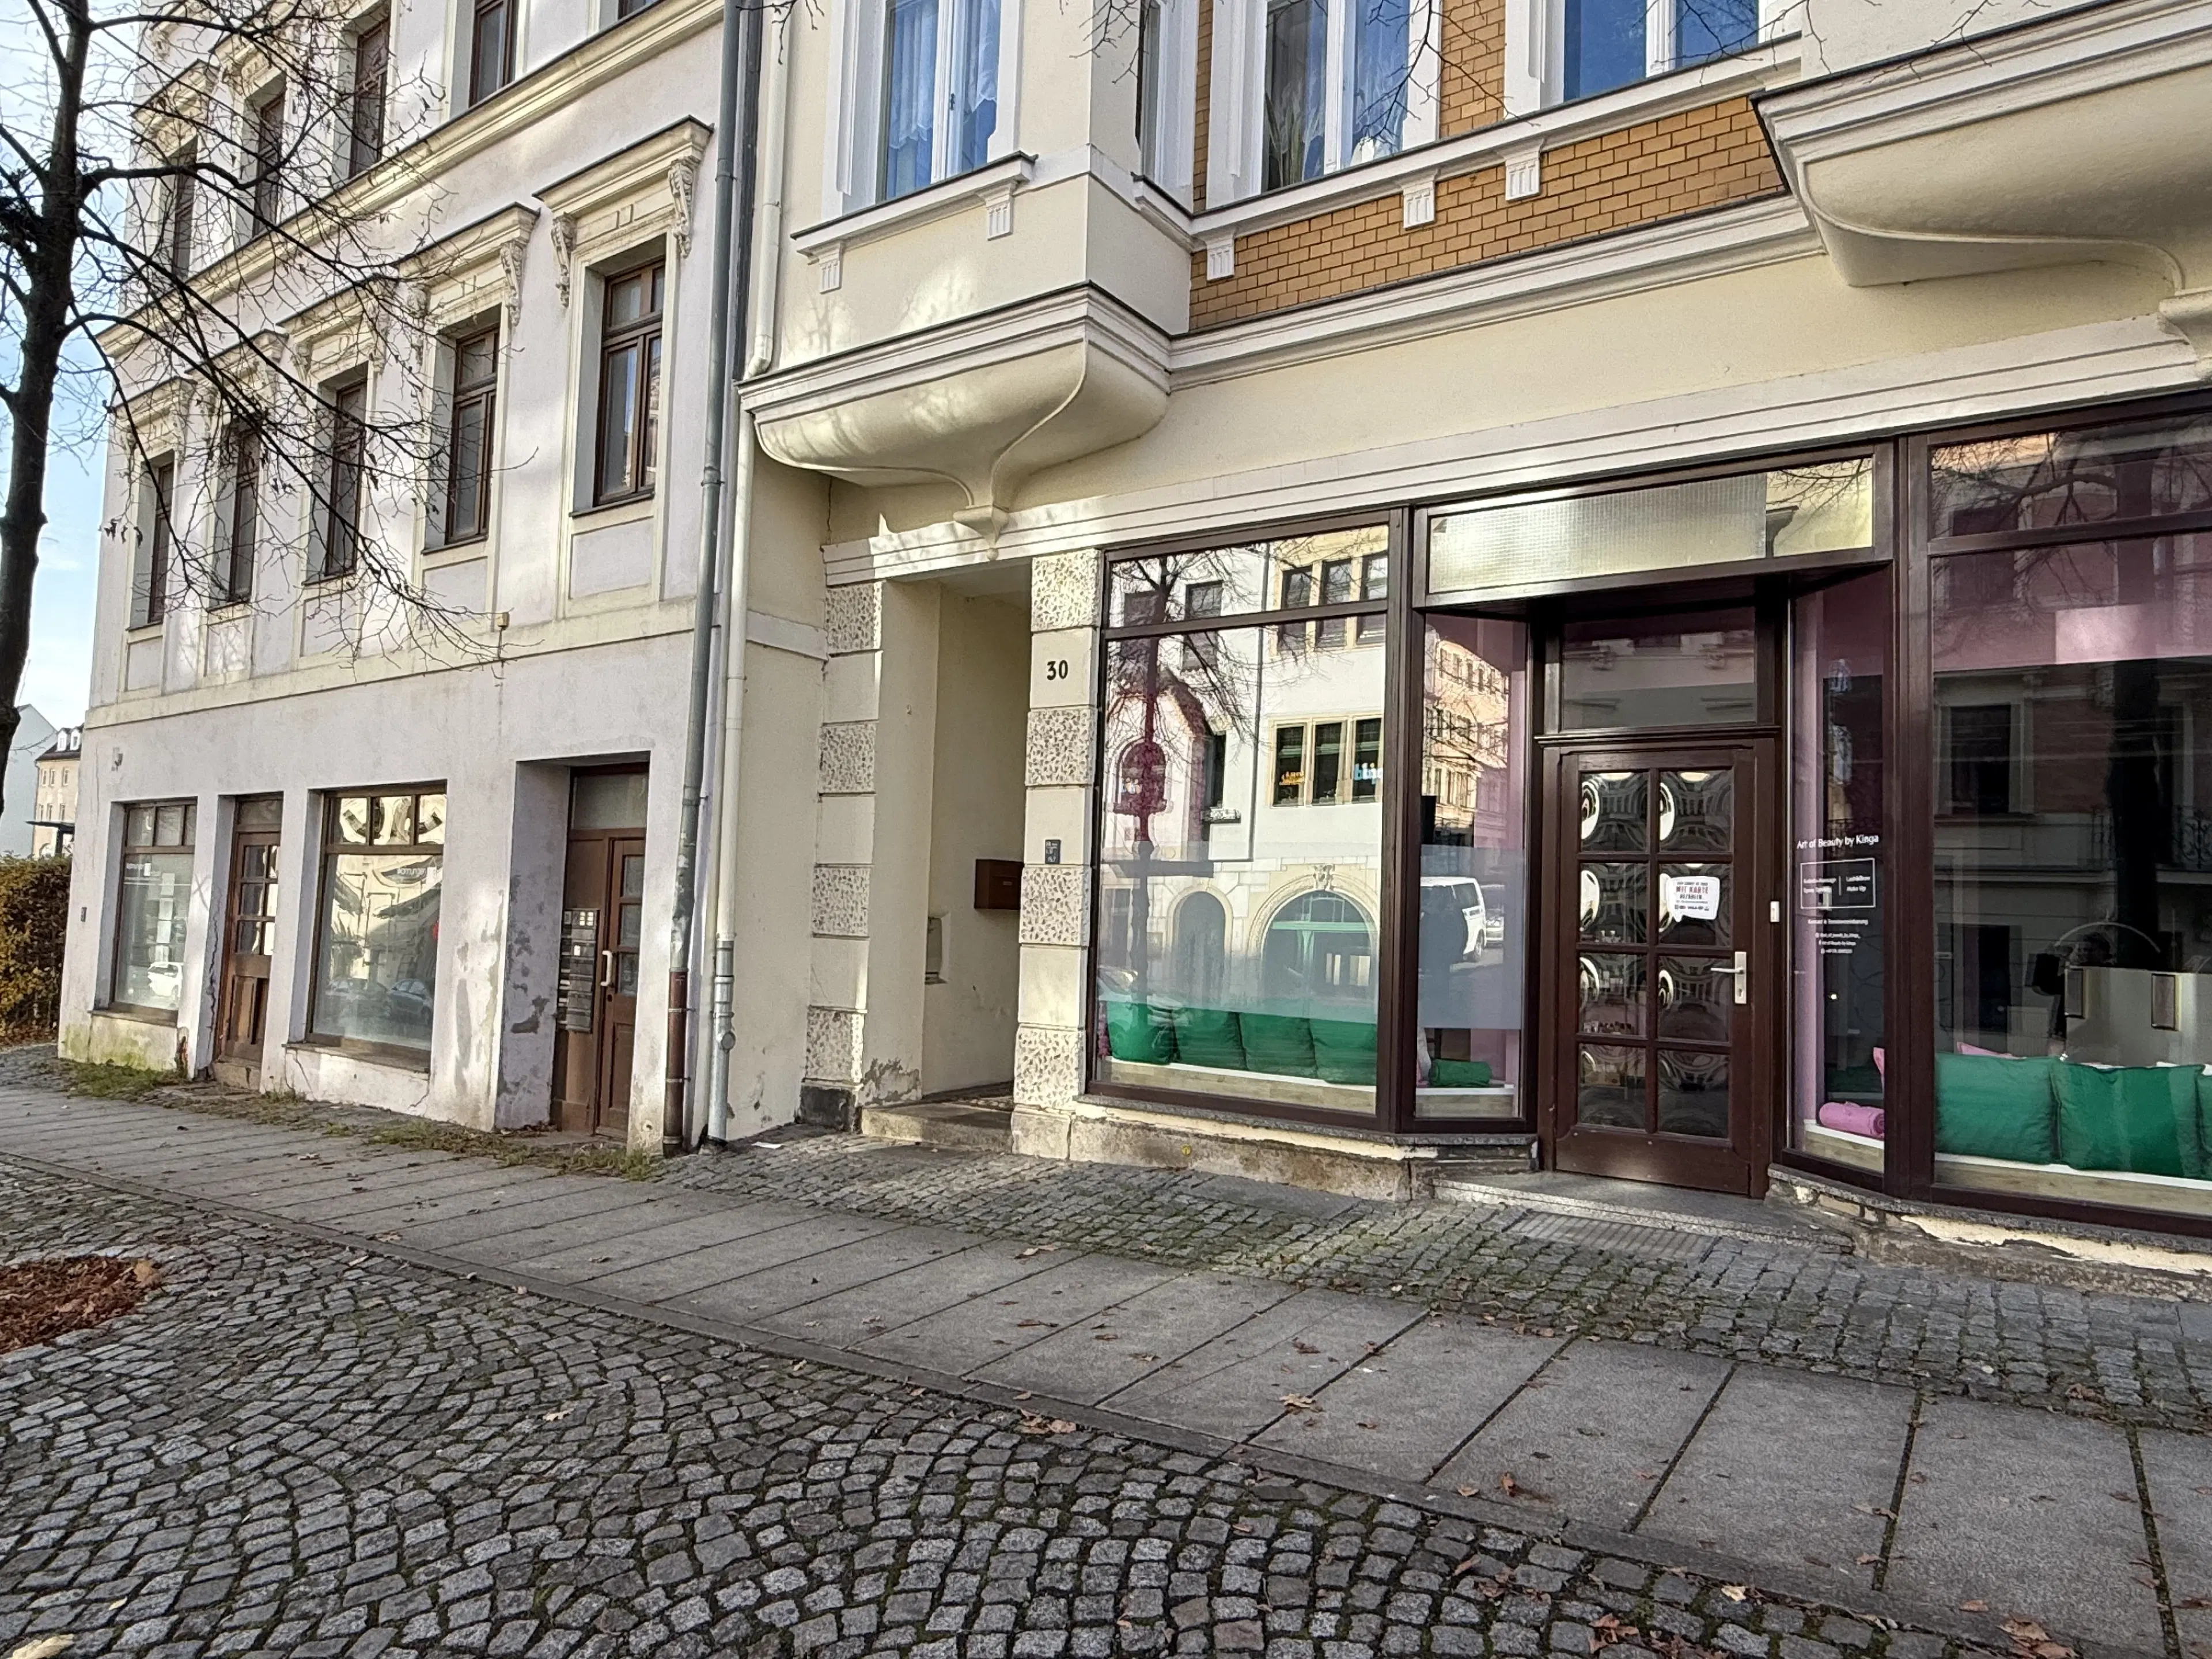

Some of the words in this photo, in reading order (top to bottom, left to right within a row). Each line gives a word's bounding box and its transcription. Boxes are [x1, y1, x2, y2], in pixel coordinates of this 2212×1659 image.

[1047, 660, 1069, 680] 30
[1796, 840, 1808, 850] Art
[1809, 838, 1817, 848] of
[1818, 837, 1843, 849] Beauty
[1844, 836, 1855, 847] by
[1855, 834, 1880, 846] Kinga
